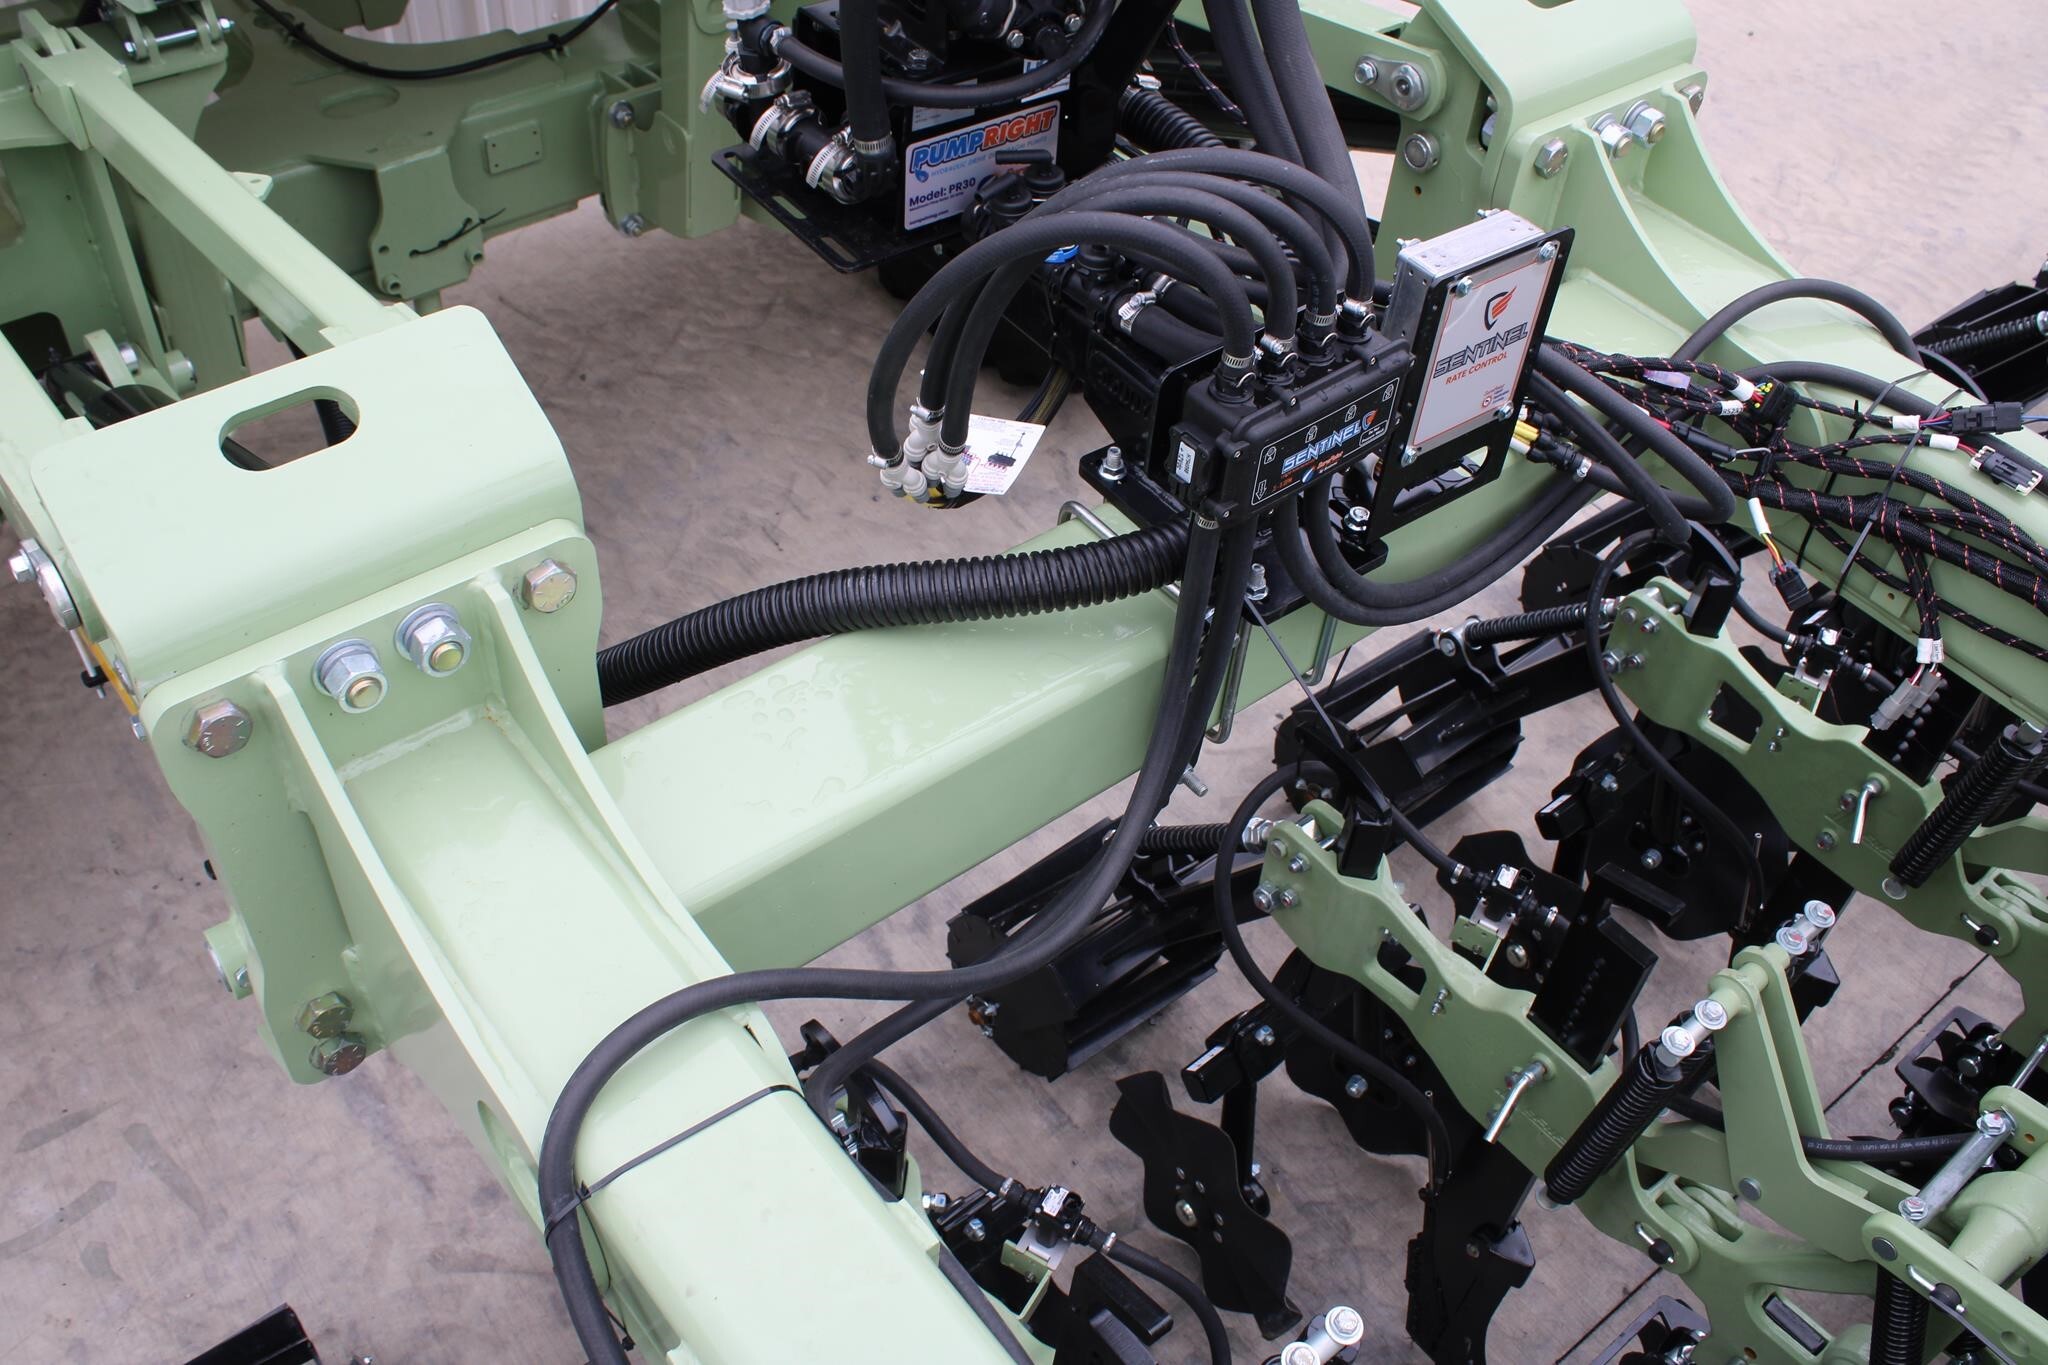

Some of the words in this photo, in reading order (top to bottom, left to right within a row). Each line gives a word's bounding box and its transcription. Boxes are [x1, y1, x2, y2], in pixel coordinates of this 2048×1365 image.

[910, 105, 1058, 174] PUMPRIGHT
[909, 187, 948, 207] Model:
[948, 177, 976, 195] PR30
[1433, 322, 1528, 379] SENTINEL
[1445, 369, 1468, 385] RATE
[1468, 351, 1508, 374] CONTROL
[1281, 419, 1362, 475] SENTINEL
